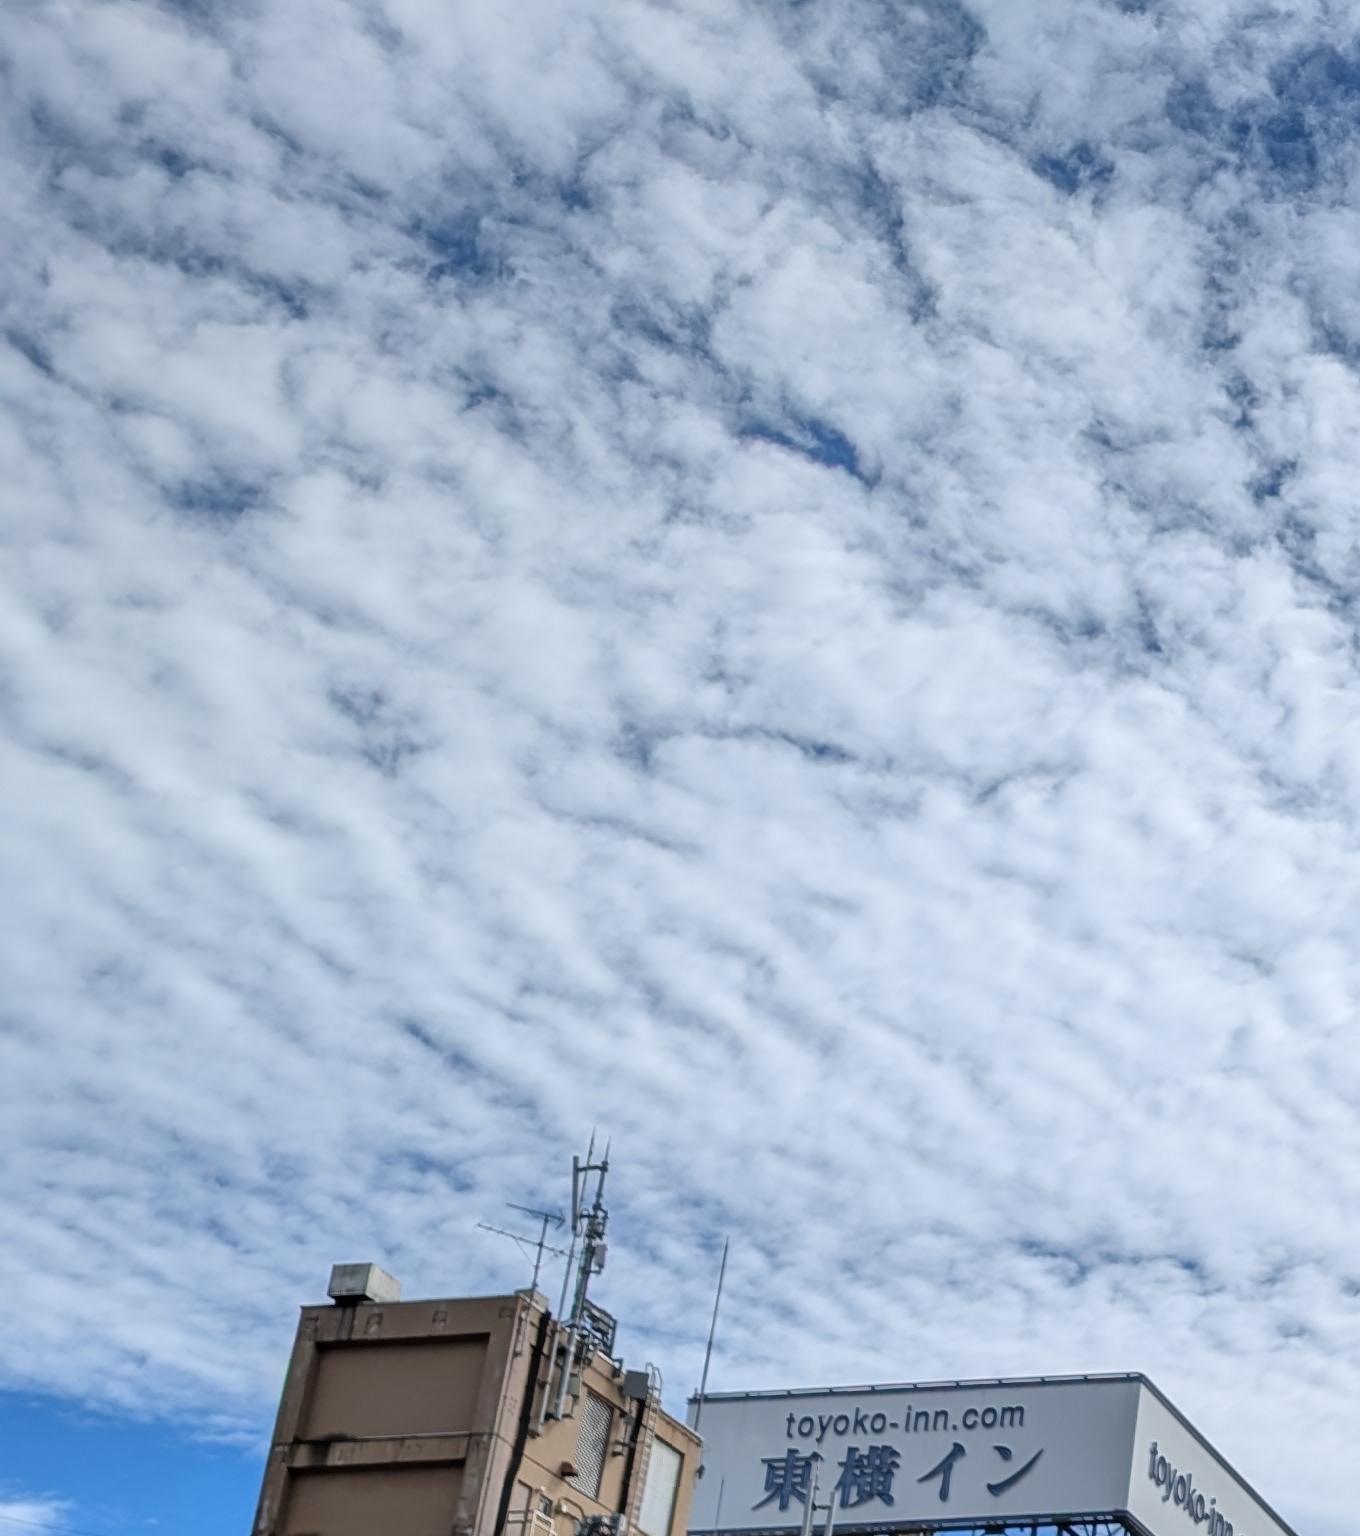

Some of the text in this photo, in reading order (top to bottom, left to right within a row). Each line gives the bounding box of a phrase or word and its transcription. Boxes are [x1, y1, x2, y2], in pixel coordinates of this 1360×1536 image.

[786, 1404, 1026, 1443] toyoko-inn.com
[752, 1442, 1045, 1512] 東横イン
